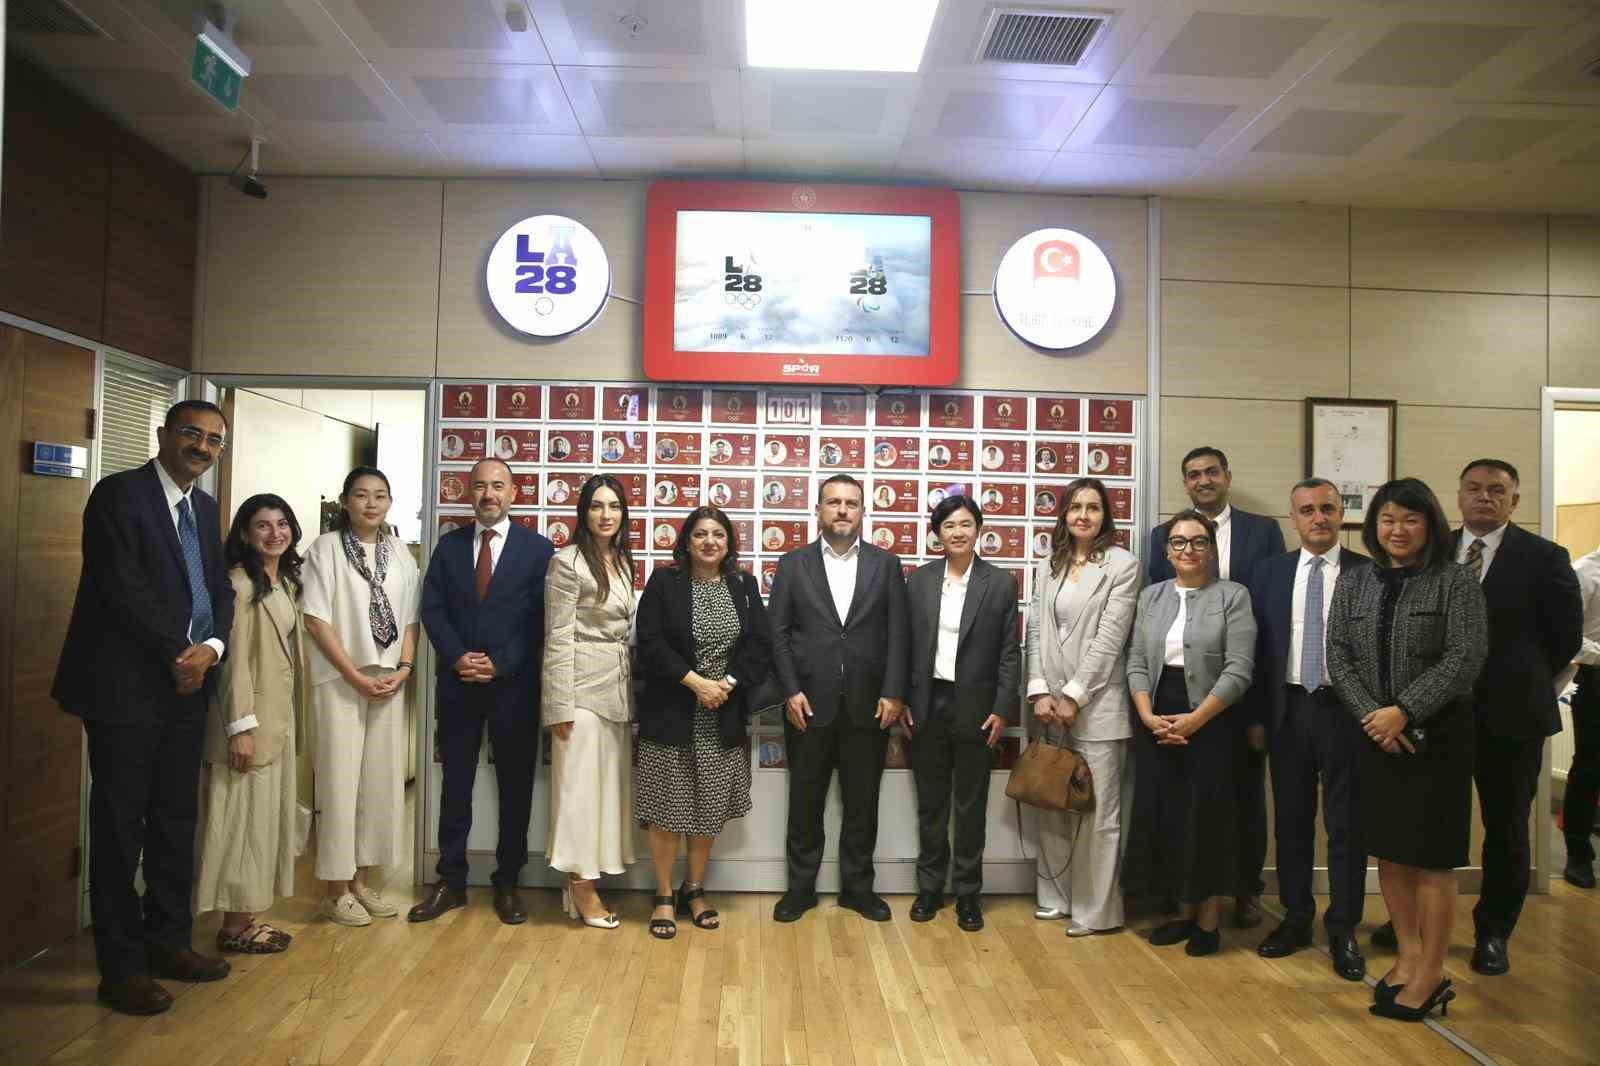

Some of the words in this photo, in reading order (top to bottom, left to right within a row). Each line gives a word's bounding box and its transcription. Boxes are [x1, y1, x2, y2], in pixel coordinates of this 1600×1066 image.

[516, 227, 577, 266] LA
[515, 265, 577, 294] 28
[725, 274, 763, 292] 28
[850, 277, 887, 295] 28
[782, 362, 820, 374] SPOR
[770, 400, 807, 419] 101
